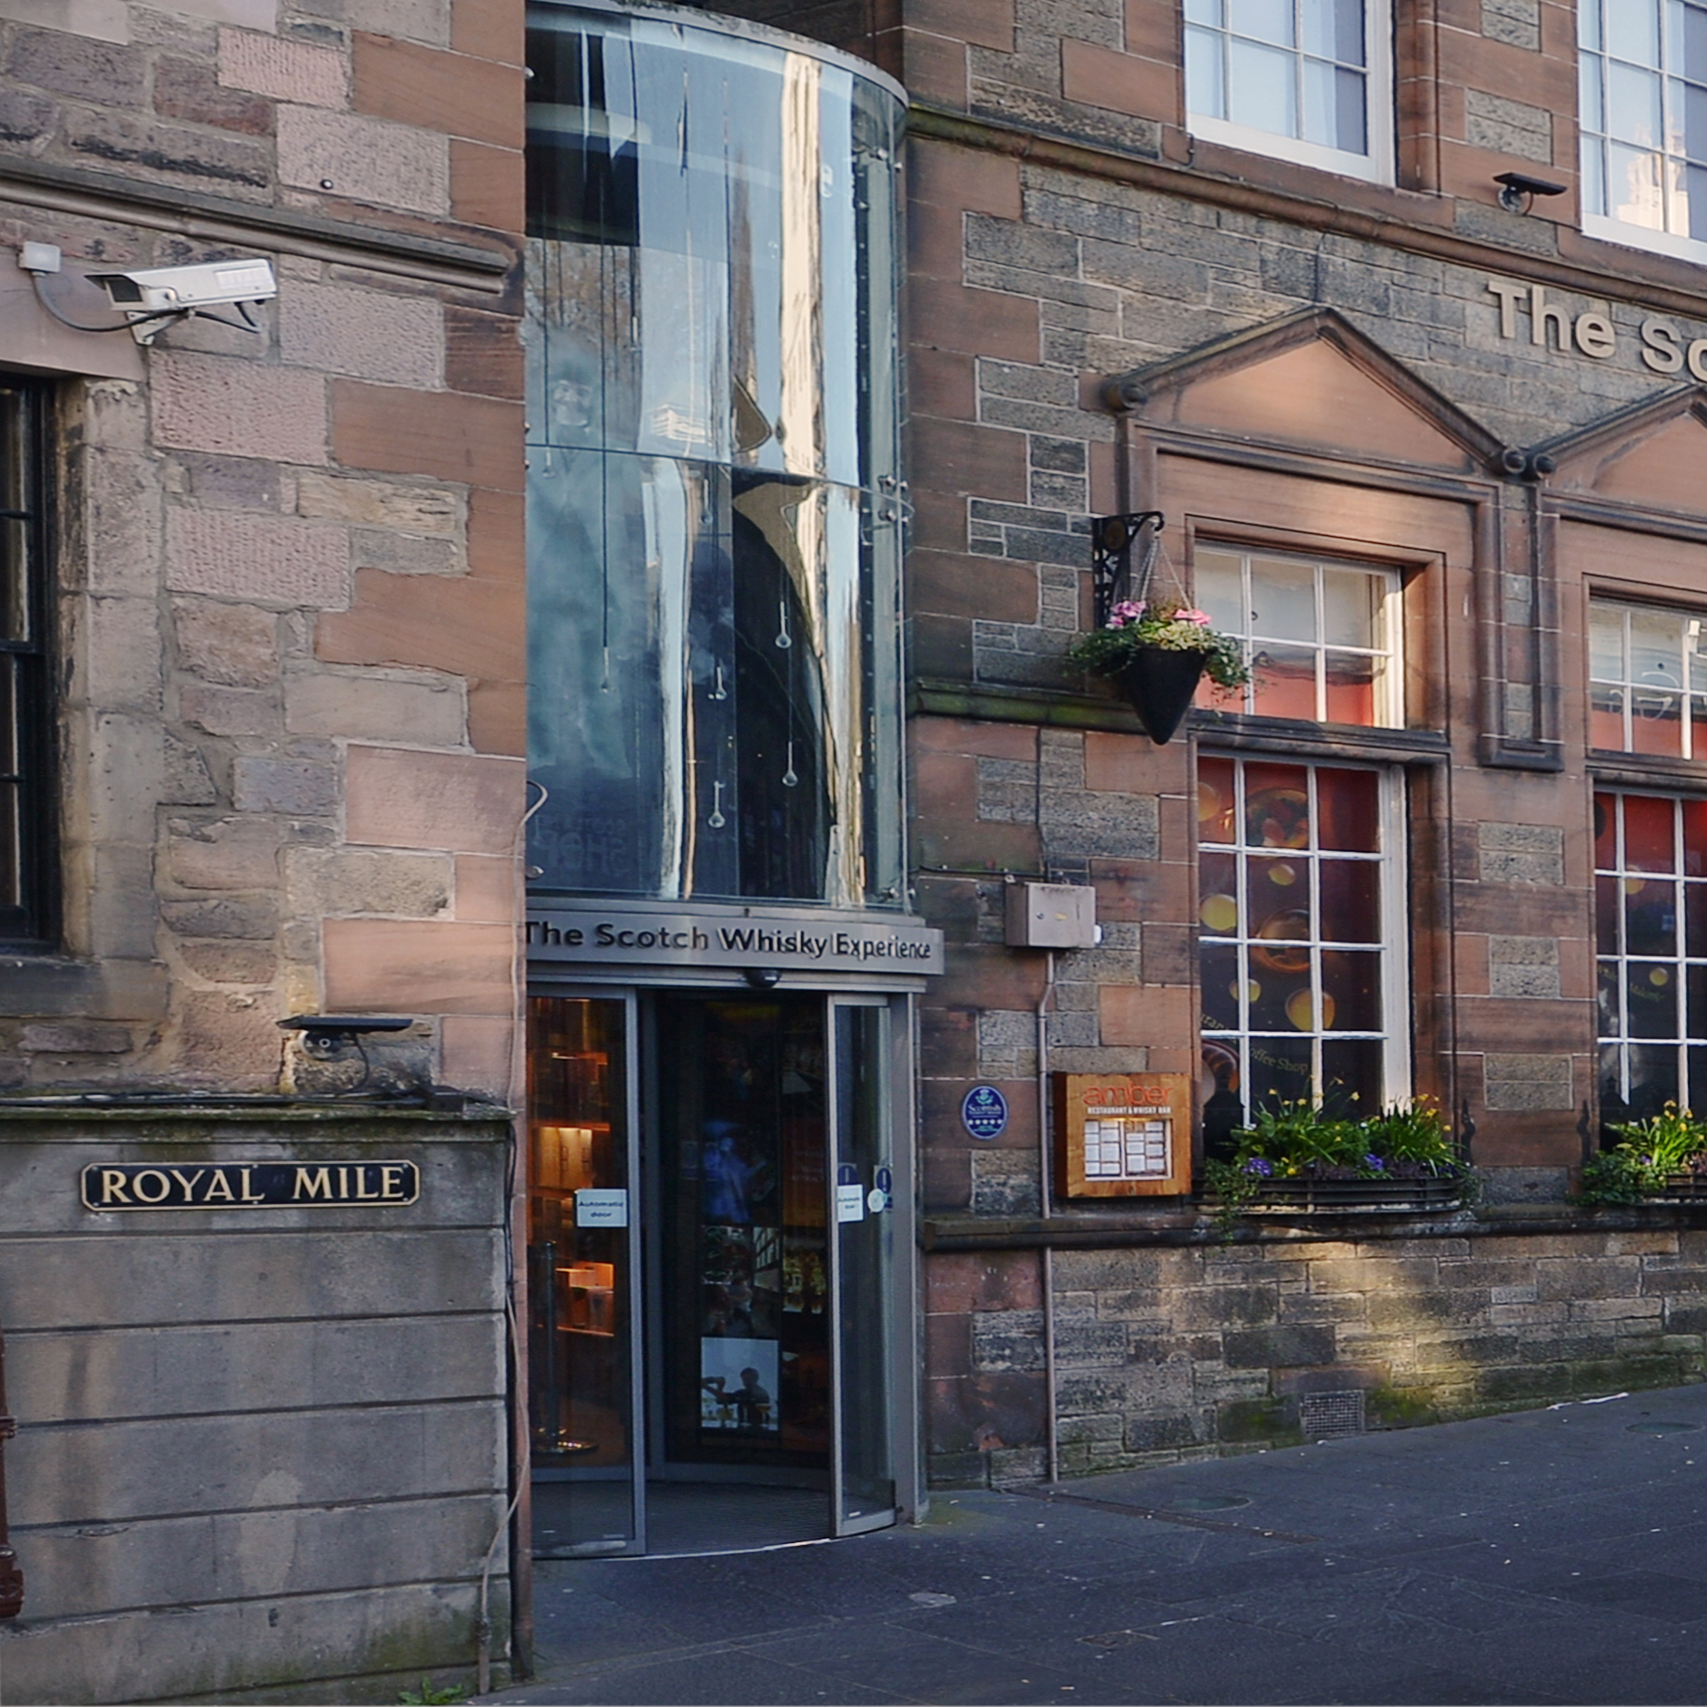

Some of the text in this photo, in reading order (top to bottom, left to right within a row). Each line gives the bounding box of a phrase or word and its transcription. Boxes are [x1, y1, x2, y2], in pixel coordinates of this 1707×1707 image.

[1487, 279, 1616, 359] The
[525, 921, 932, 961] The Scotch Whisky Experience
[1083, 1080, 1174, 1106] amber
[100, 1166, 405, 1204] ROYAL MILE
